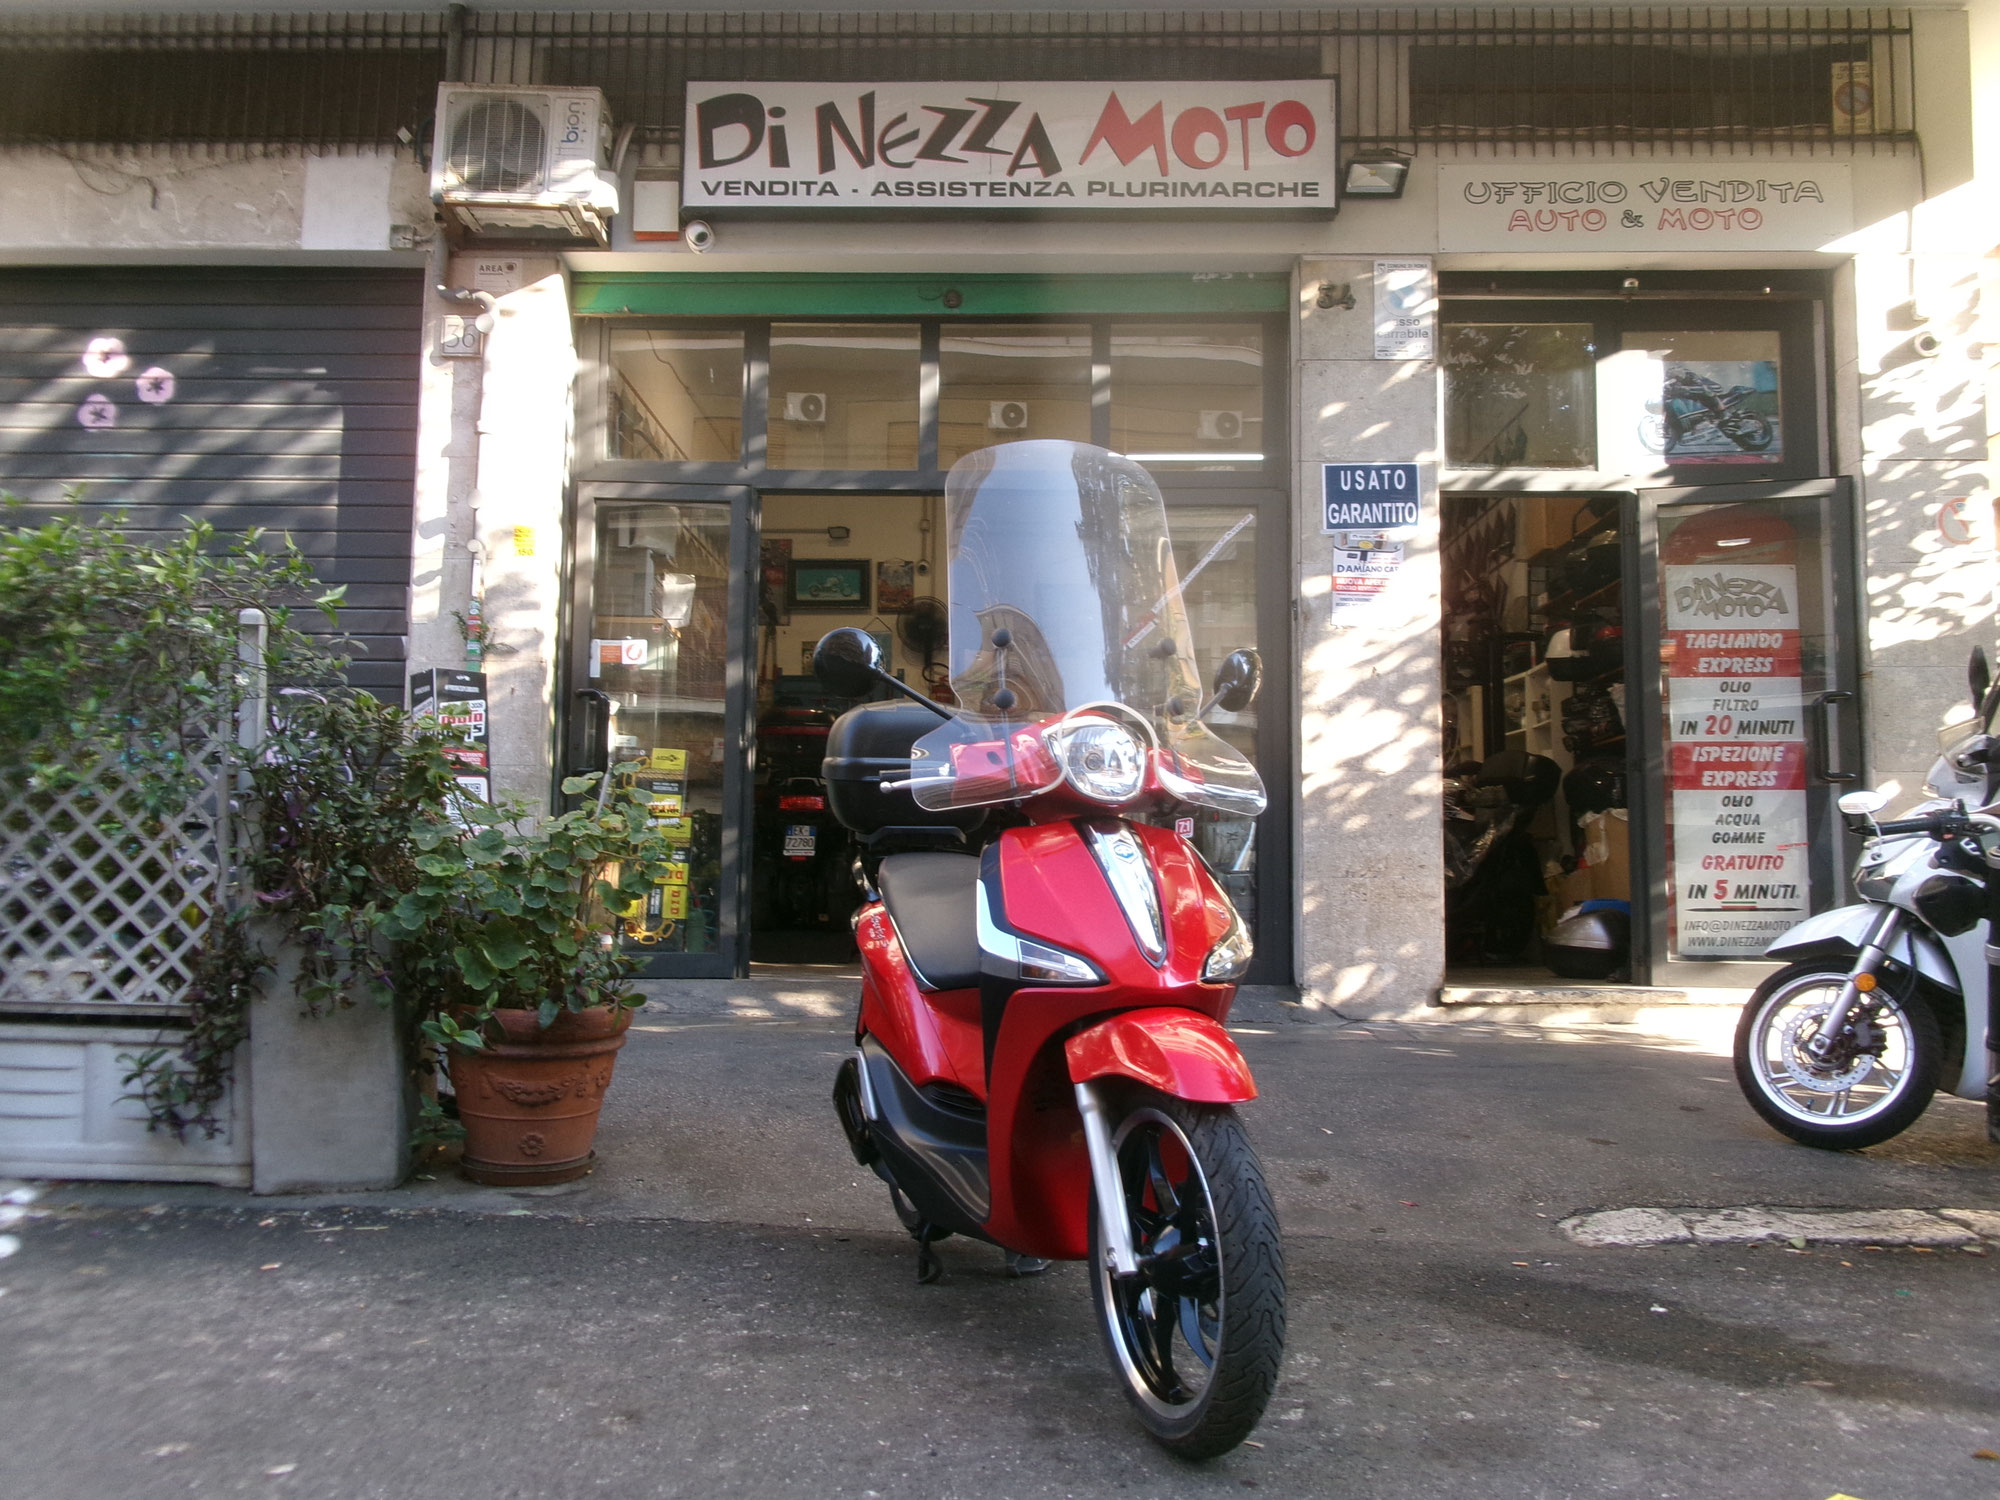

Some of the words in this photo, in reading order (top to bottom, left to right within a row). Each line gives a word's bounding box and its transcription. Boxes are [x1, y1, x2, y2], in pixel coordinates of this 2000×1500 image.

[560, 102, 581, 143] bion
[696, 93, 790, 169] Di
[1078, 90, 1316, 177] MOTO
[701, 181, 840, 197] VENDITA
[871, 181, 1075, 197] ASSISTENZA
[1087, 181, 1320, 197] PLURIMARCHE
[1464, 181, 1628, 204] UFFICIO
[1640, 177, 1824, 203] VENDITA
[1508, 209, 1607, 232] AUTO
[1620, 209, 1644, 228] &
[1657, 208, 1763, 231] MOTO
[445, 324, 476, 349] 36
[1340, 469, 1406, 491] USATO
[1328, 502, 1417, 525] GARANTITO
[1336, 564, 1383, 573] DAMIANO
[1692, 596, 1766, 620] MOTO
[1685, 633, 1783, 649] TAGLIANDO
[1698, 656, 1774, 673] EXPRESS
[1720, 681, 1751, 693] OLIO
[1712, 699, 1760, 711] FILTRO
[1680, 720, 1699, 735] IN
[1704, 714, 1733, 735] 20
[1736, 720, 1795, 735] MINUTI
[1692, 746, 1785, 762] ISPEZIONE
[1702, 770, 1779, 787] EXPRESS
[1721, 795, 1754, 807] OLIO
[1715, 814, 1761, 826] ACQUA
[786, 837, 814, 848] 72780
[1711, 832, 1767, 844] GOMME
[1702, 855, 1784, 871] GRATUITO
[1687, 884, 1708, 899] IN
[1713, 879, 1729, 900] 5
[1688, 936, 1777, 947] WWW.DINEZZAM
